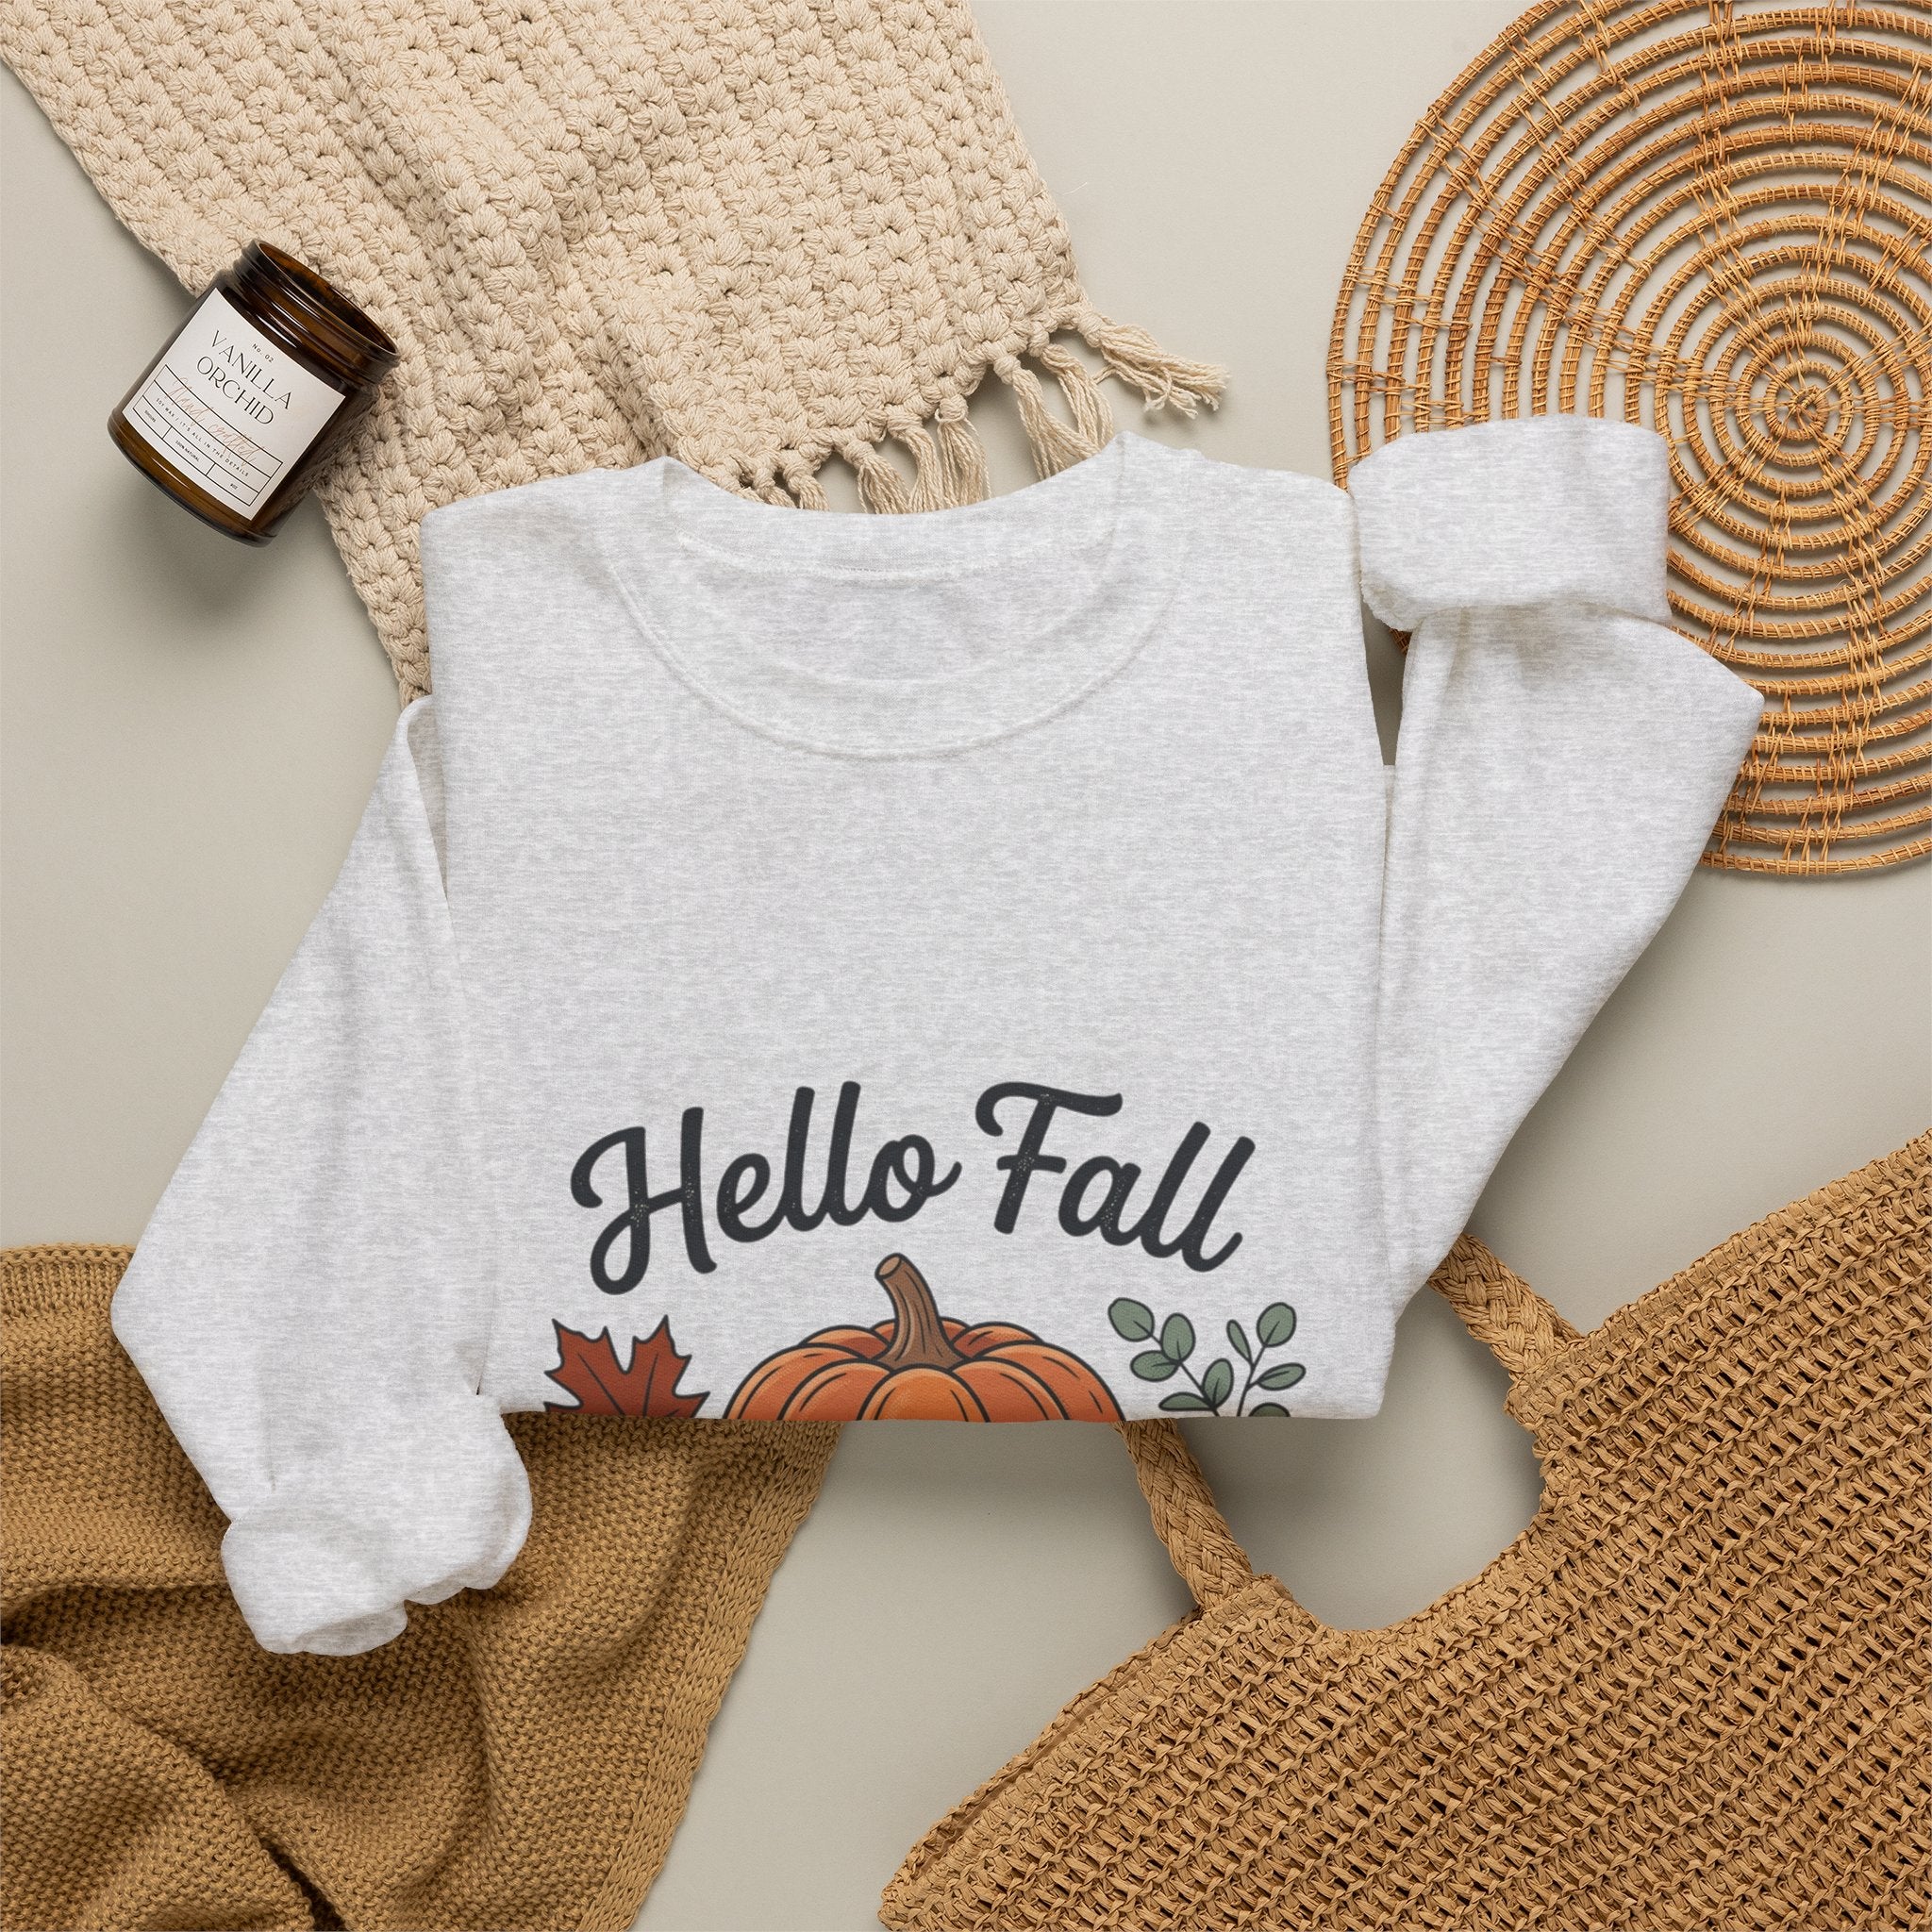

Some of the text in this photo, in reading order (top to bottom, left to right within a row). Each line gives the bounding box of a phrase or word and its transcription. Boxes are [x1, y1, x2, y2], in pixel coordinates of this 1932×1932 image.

[196, 356, 275, 425] ORCHID
[211, 329, 292, 409] VANILLA
[264, 354, 275, 363] 02
[192, 432, 202, 442] ALL
[212, 448, 224, 458] THE
[225, 458, 249, 477] DETAILS
[570, 1081, 1256, 1294] Hello Fall
